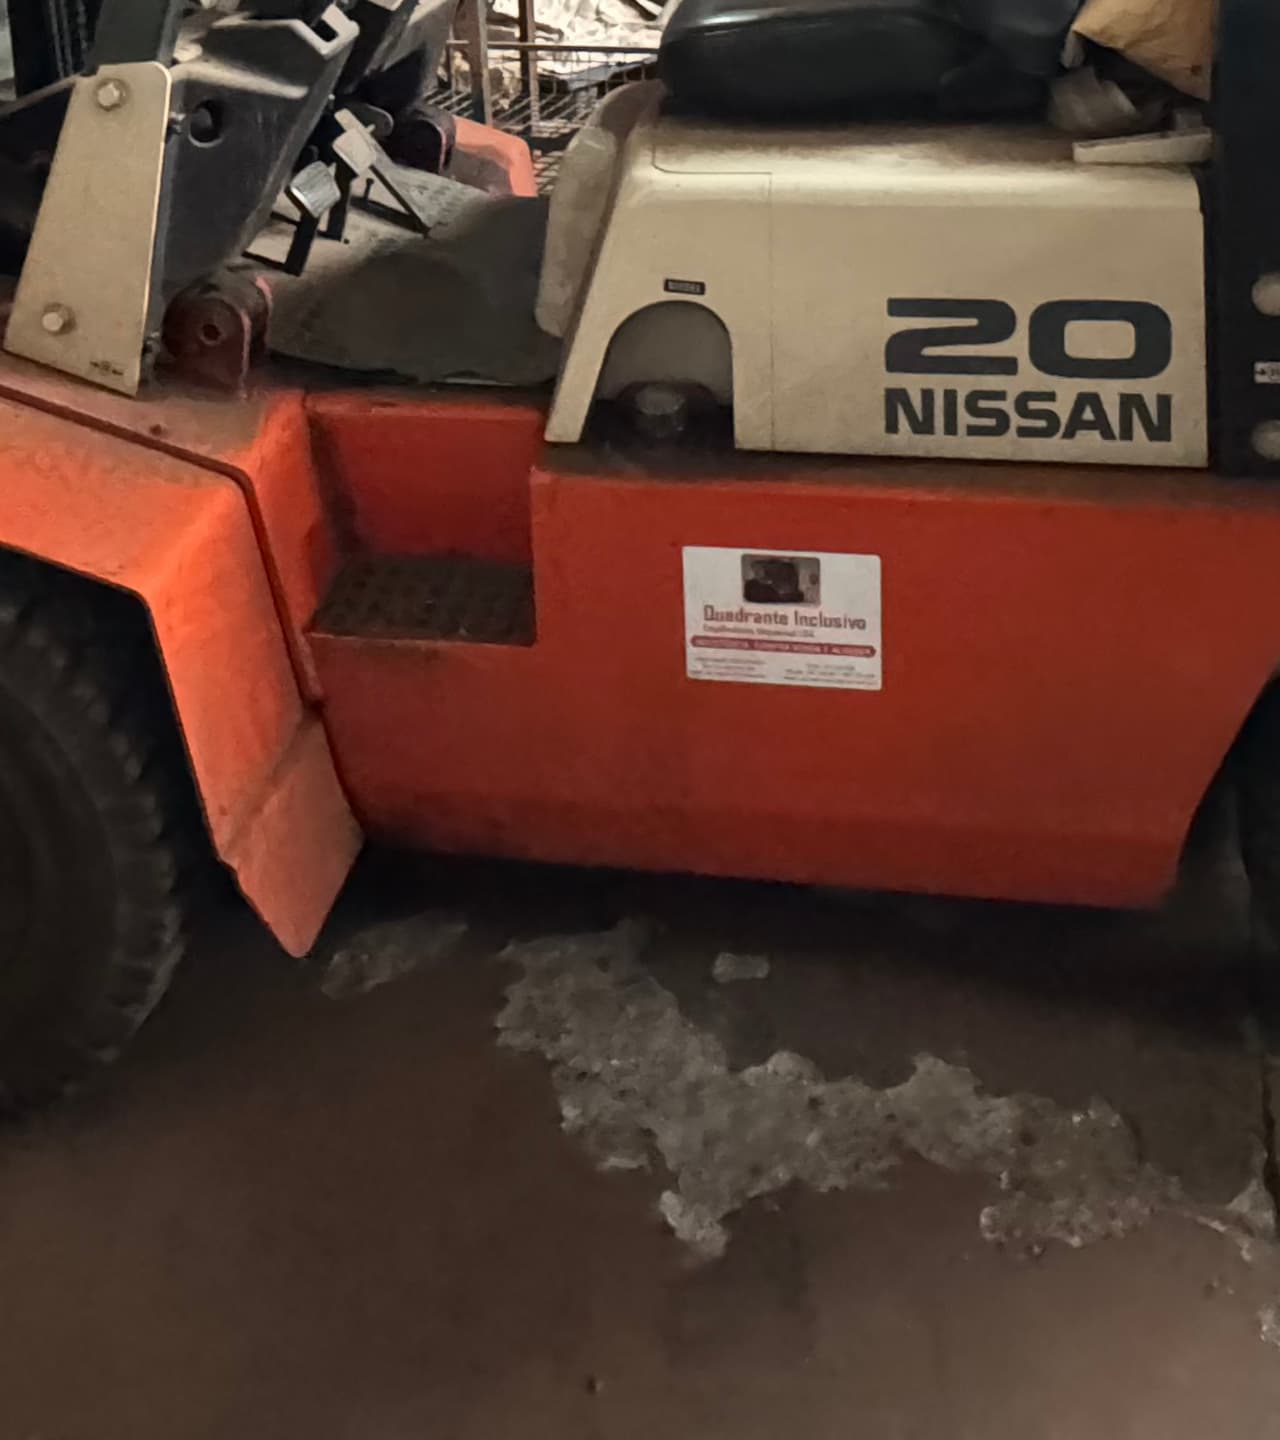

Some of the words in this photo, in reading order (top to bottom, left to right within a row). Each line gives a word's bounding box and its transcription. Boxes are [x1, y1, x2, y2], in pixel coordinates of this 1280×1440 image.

[884, 297, 1173, 380] 20
[884, 387, 1173, 443] NISSAN
[793, 609, 867, 630] Inclusivo
